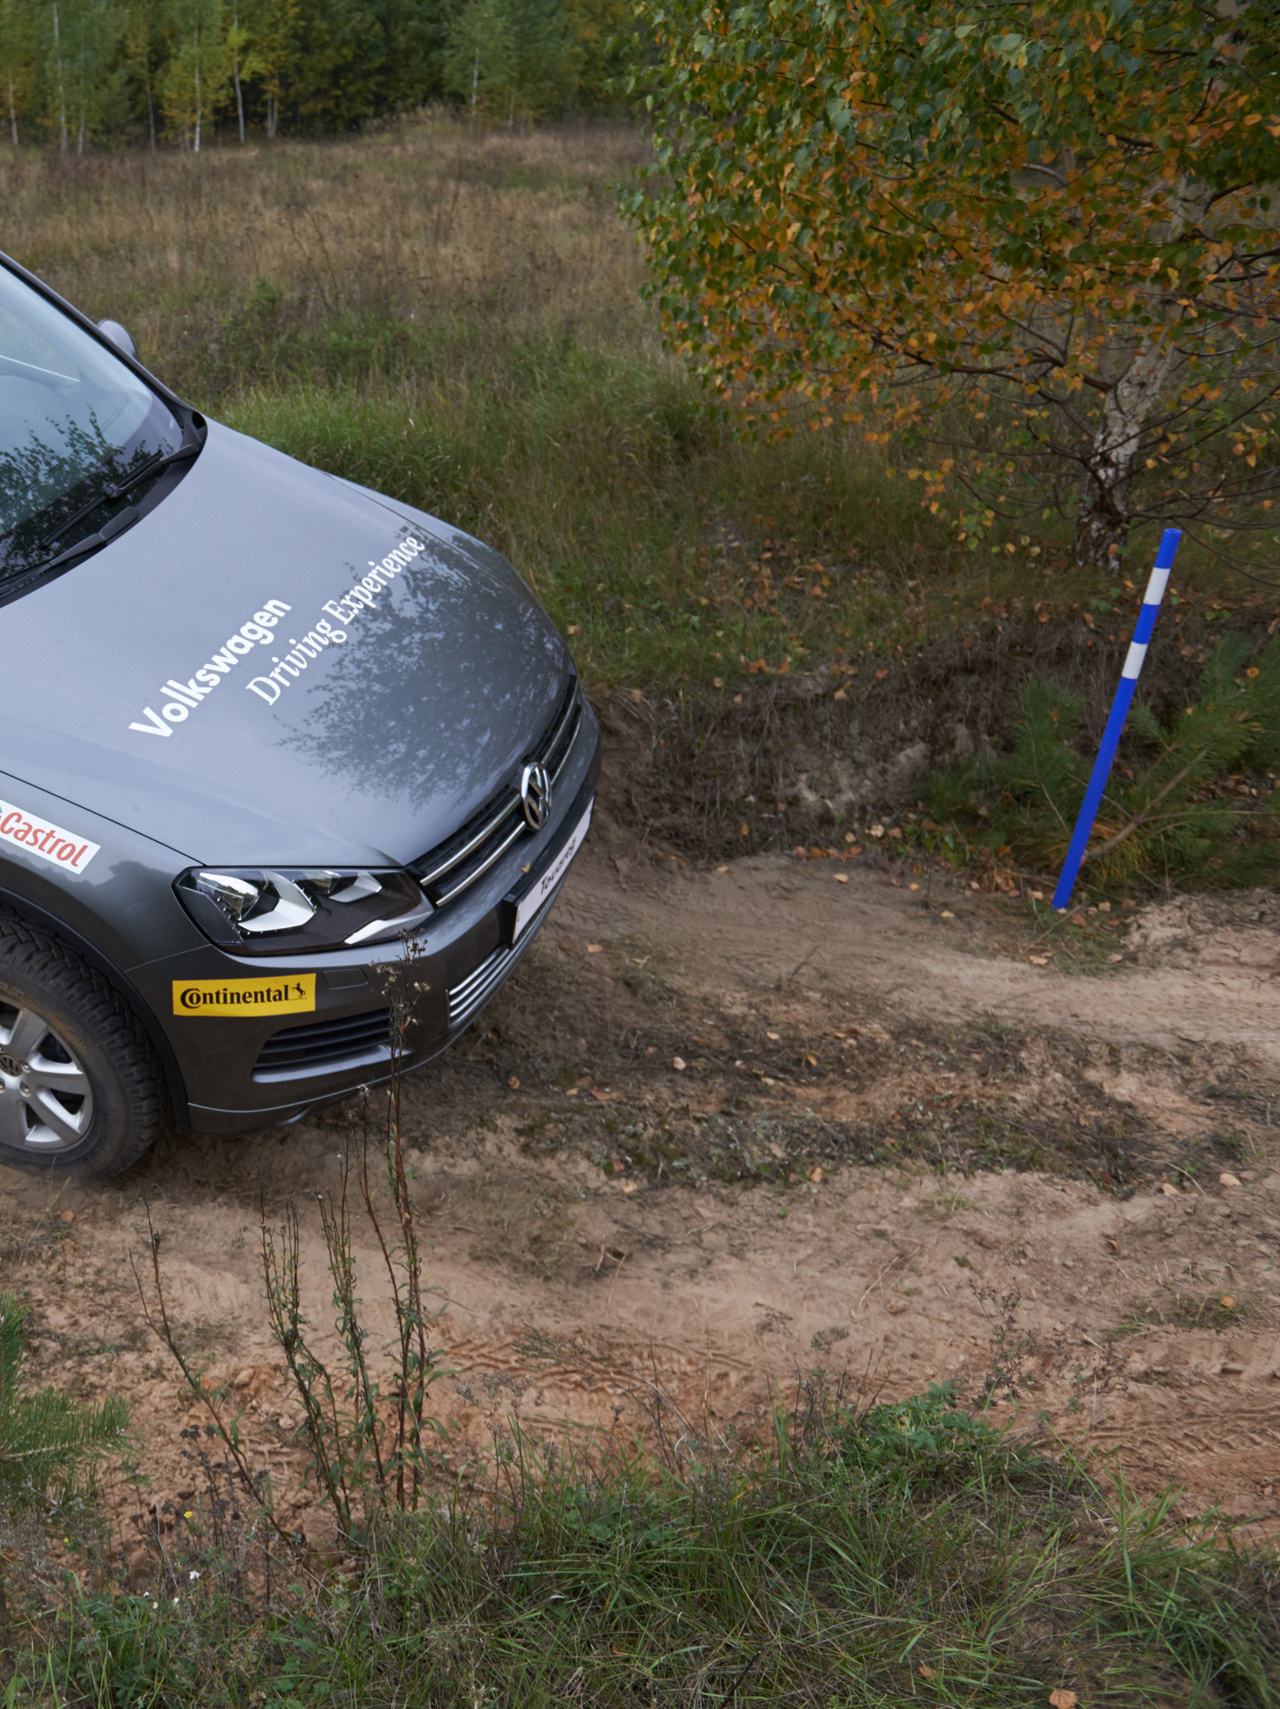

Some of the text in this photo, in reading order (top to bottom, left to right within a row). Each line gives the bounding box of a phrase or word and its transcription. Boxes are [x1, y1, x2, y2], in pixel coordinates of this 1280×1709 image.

[128, 599, 292, 738] Volkswagen
[245, 536, 426, 706] Driving Experience
[0, 812, 89, 867] Castrol
[180, 985, 289, 1009] Continental
